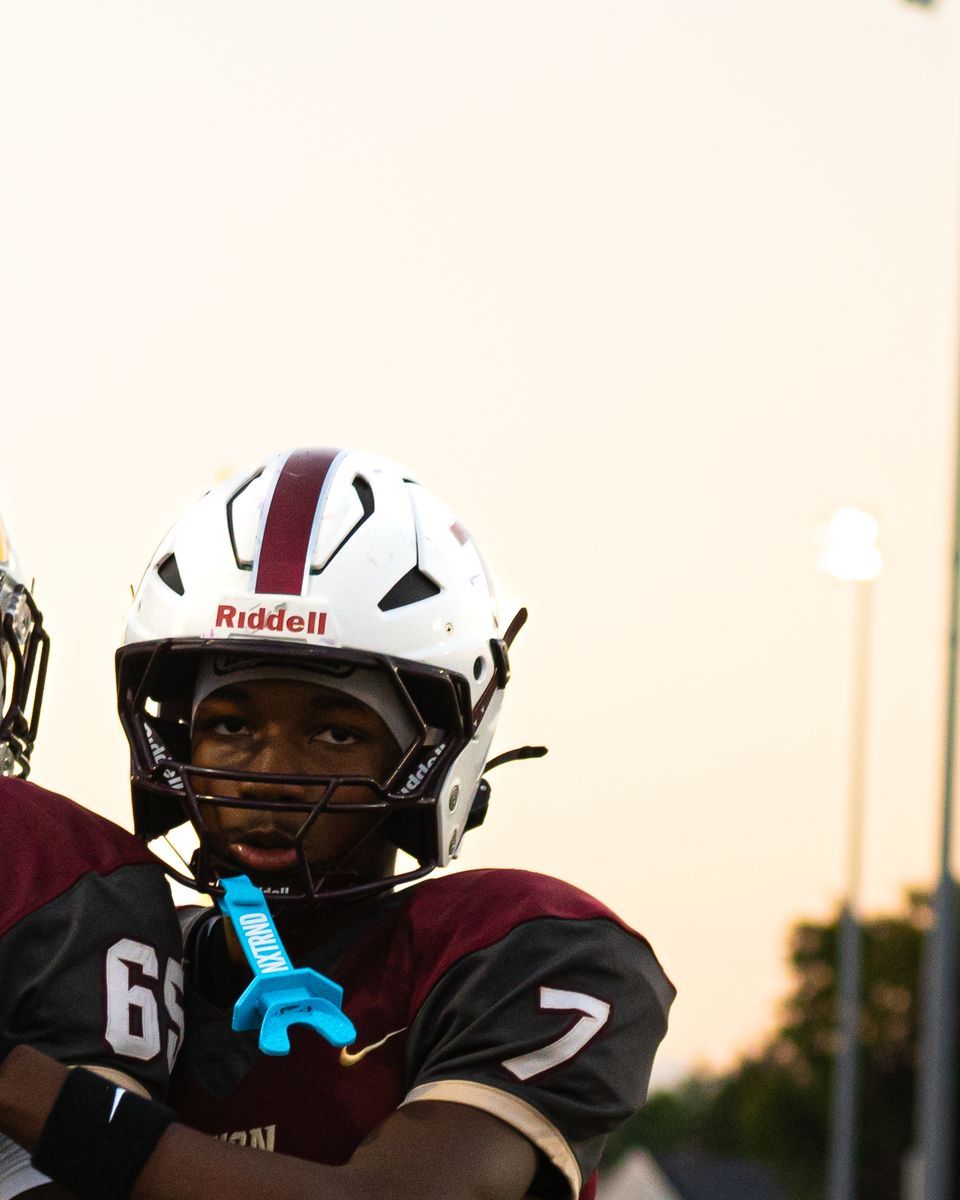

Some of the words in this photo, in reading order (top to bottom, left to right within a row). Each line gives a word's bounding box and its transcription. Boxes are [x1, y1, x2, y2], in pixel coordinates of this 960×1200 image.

[215, 604, 328, 636] Riddell
[239, 912, 290, 975] NXTRND
[500, 985, 611, 1081] 7
